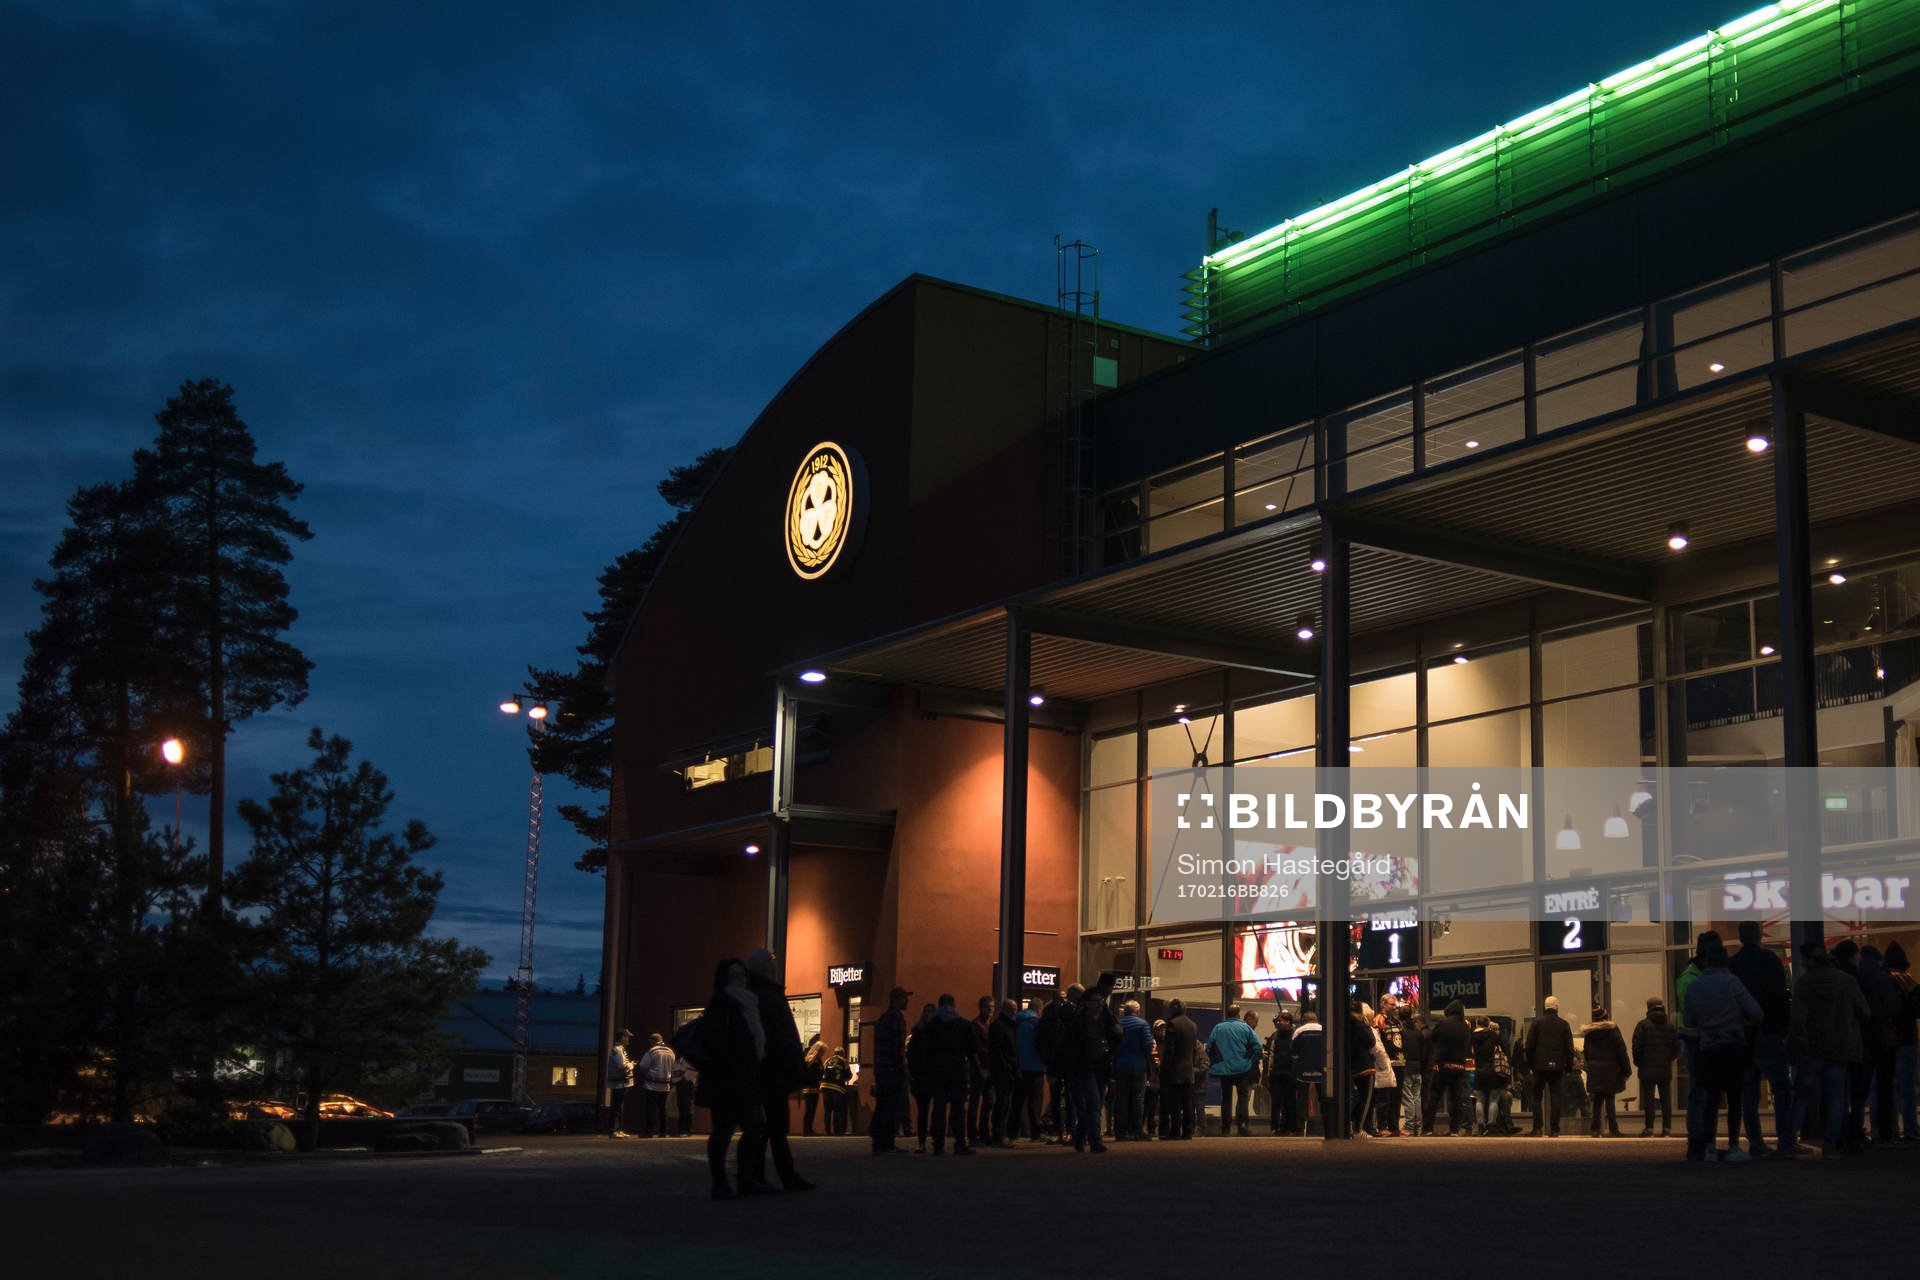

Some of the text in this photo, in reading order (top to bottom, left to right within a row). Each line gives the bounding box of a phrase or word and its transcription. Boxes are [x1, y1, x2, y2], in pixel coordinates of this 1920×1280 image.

[811, 454, 829, 473] 1912
[1723, 870, 1910, 911] Skbar
[1562, 917, 1583, 949] 2
[1388, 933, 1401, 963] 1
[830, 967, 864, 986] Biljetter
[1022, 969, 1057, 986] etter
[1432, 979, 1481, 999] Skybar
